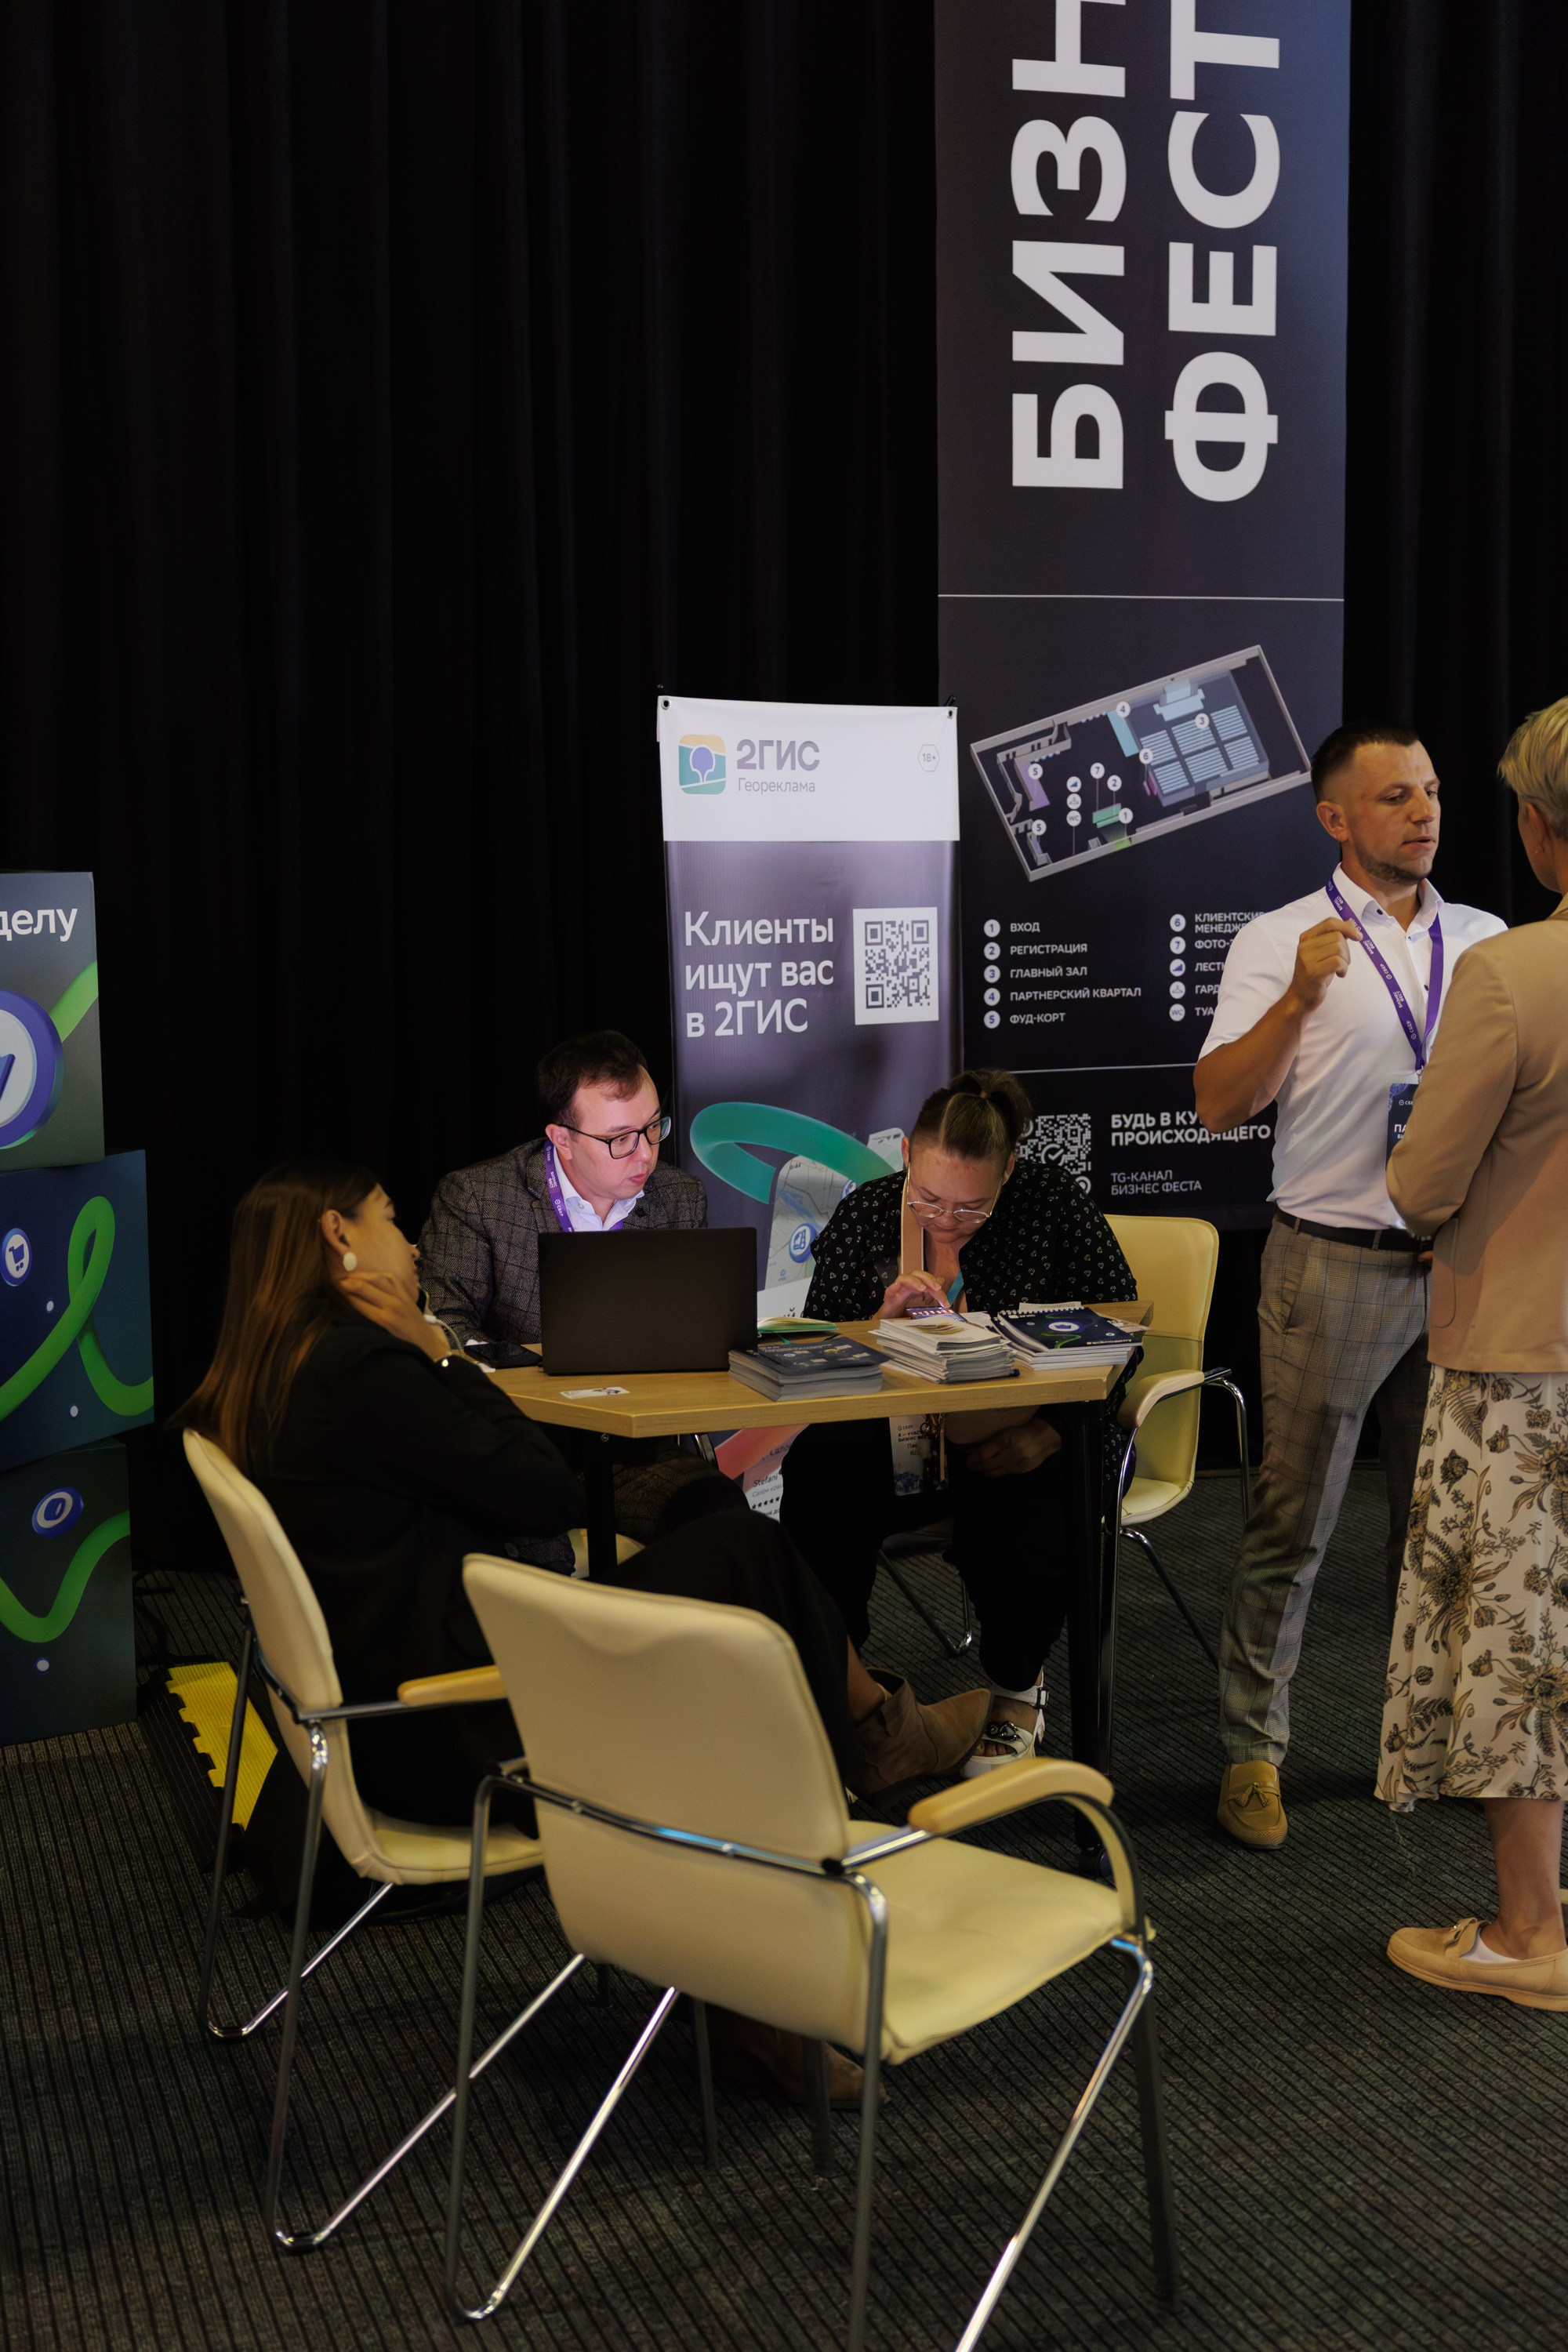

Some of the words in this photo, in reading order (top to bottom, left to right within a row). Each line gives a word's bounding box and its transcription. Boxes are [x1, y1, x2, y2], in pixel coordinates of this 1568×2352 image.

[1165, 0, 1280, 502] ФЕСТ
[736, 739, 820, 771] 2ГИС
[922, 753, 936, 763] 18+
[738, 777, 816, 795] Геореклама
[684, 910, 834, 947] Клиенты
[1010, 921, 1040, 934] ВХОД
[1010, 942, 1088, 956] РЕГИСТРАЦИЯ
[685, 961, 771, 997] ищут
[781, 959, 834, 987] вас
[1010, 965, 1063, 979] ГЛАВНЫЙ
[1065, 966, 1088, 977] ЗАЛ
[1010, 987, 1090, 1002] ПАРТНЕРСКИЙ
[1092, 986, 1142, 1000] КВАРТАЛ
[686, 1011, 706, 1038] в
[714, 997, 808, 1037] 2ГИС
[1009, 1012, 1066, 1025] ФУД-КОРТ
[1111, 1112, 1156, 1131] БУДЬ
[1160, 1112, 1171, 1127] В
[1175, 1110, 1203, 1126] КУ
[1110, 1169, 1173, 1184] TG-КАНАЛ
[1111, 1182, 1160, 1196] БИЗНЕС
[1161, 1179, 1203, 1192] ФЕСТА
